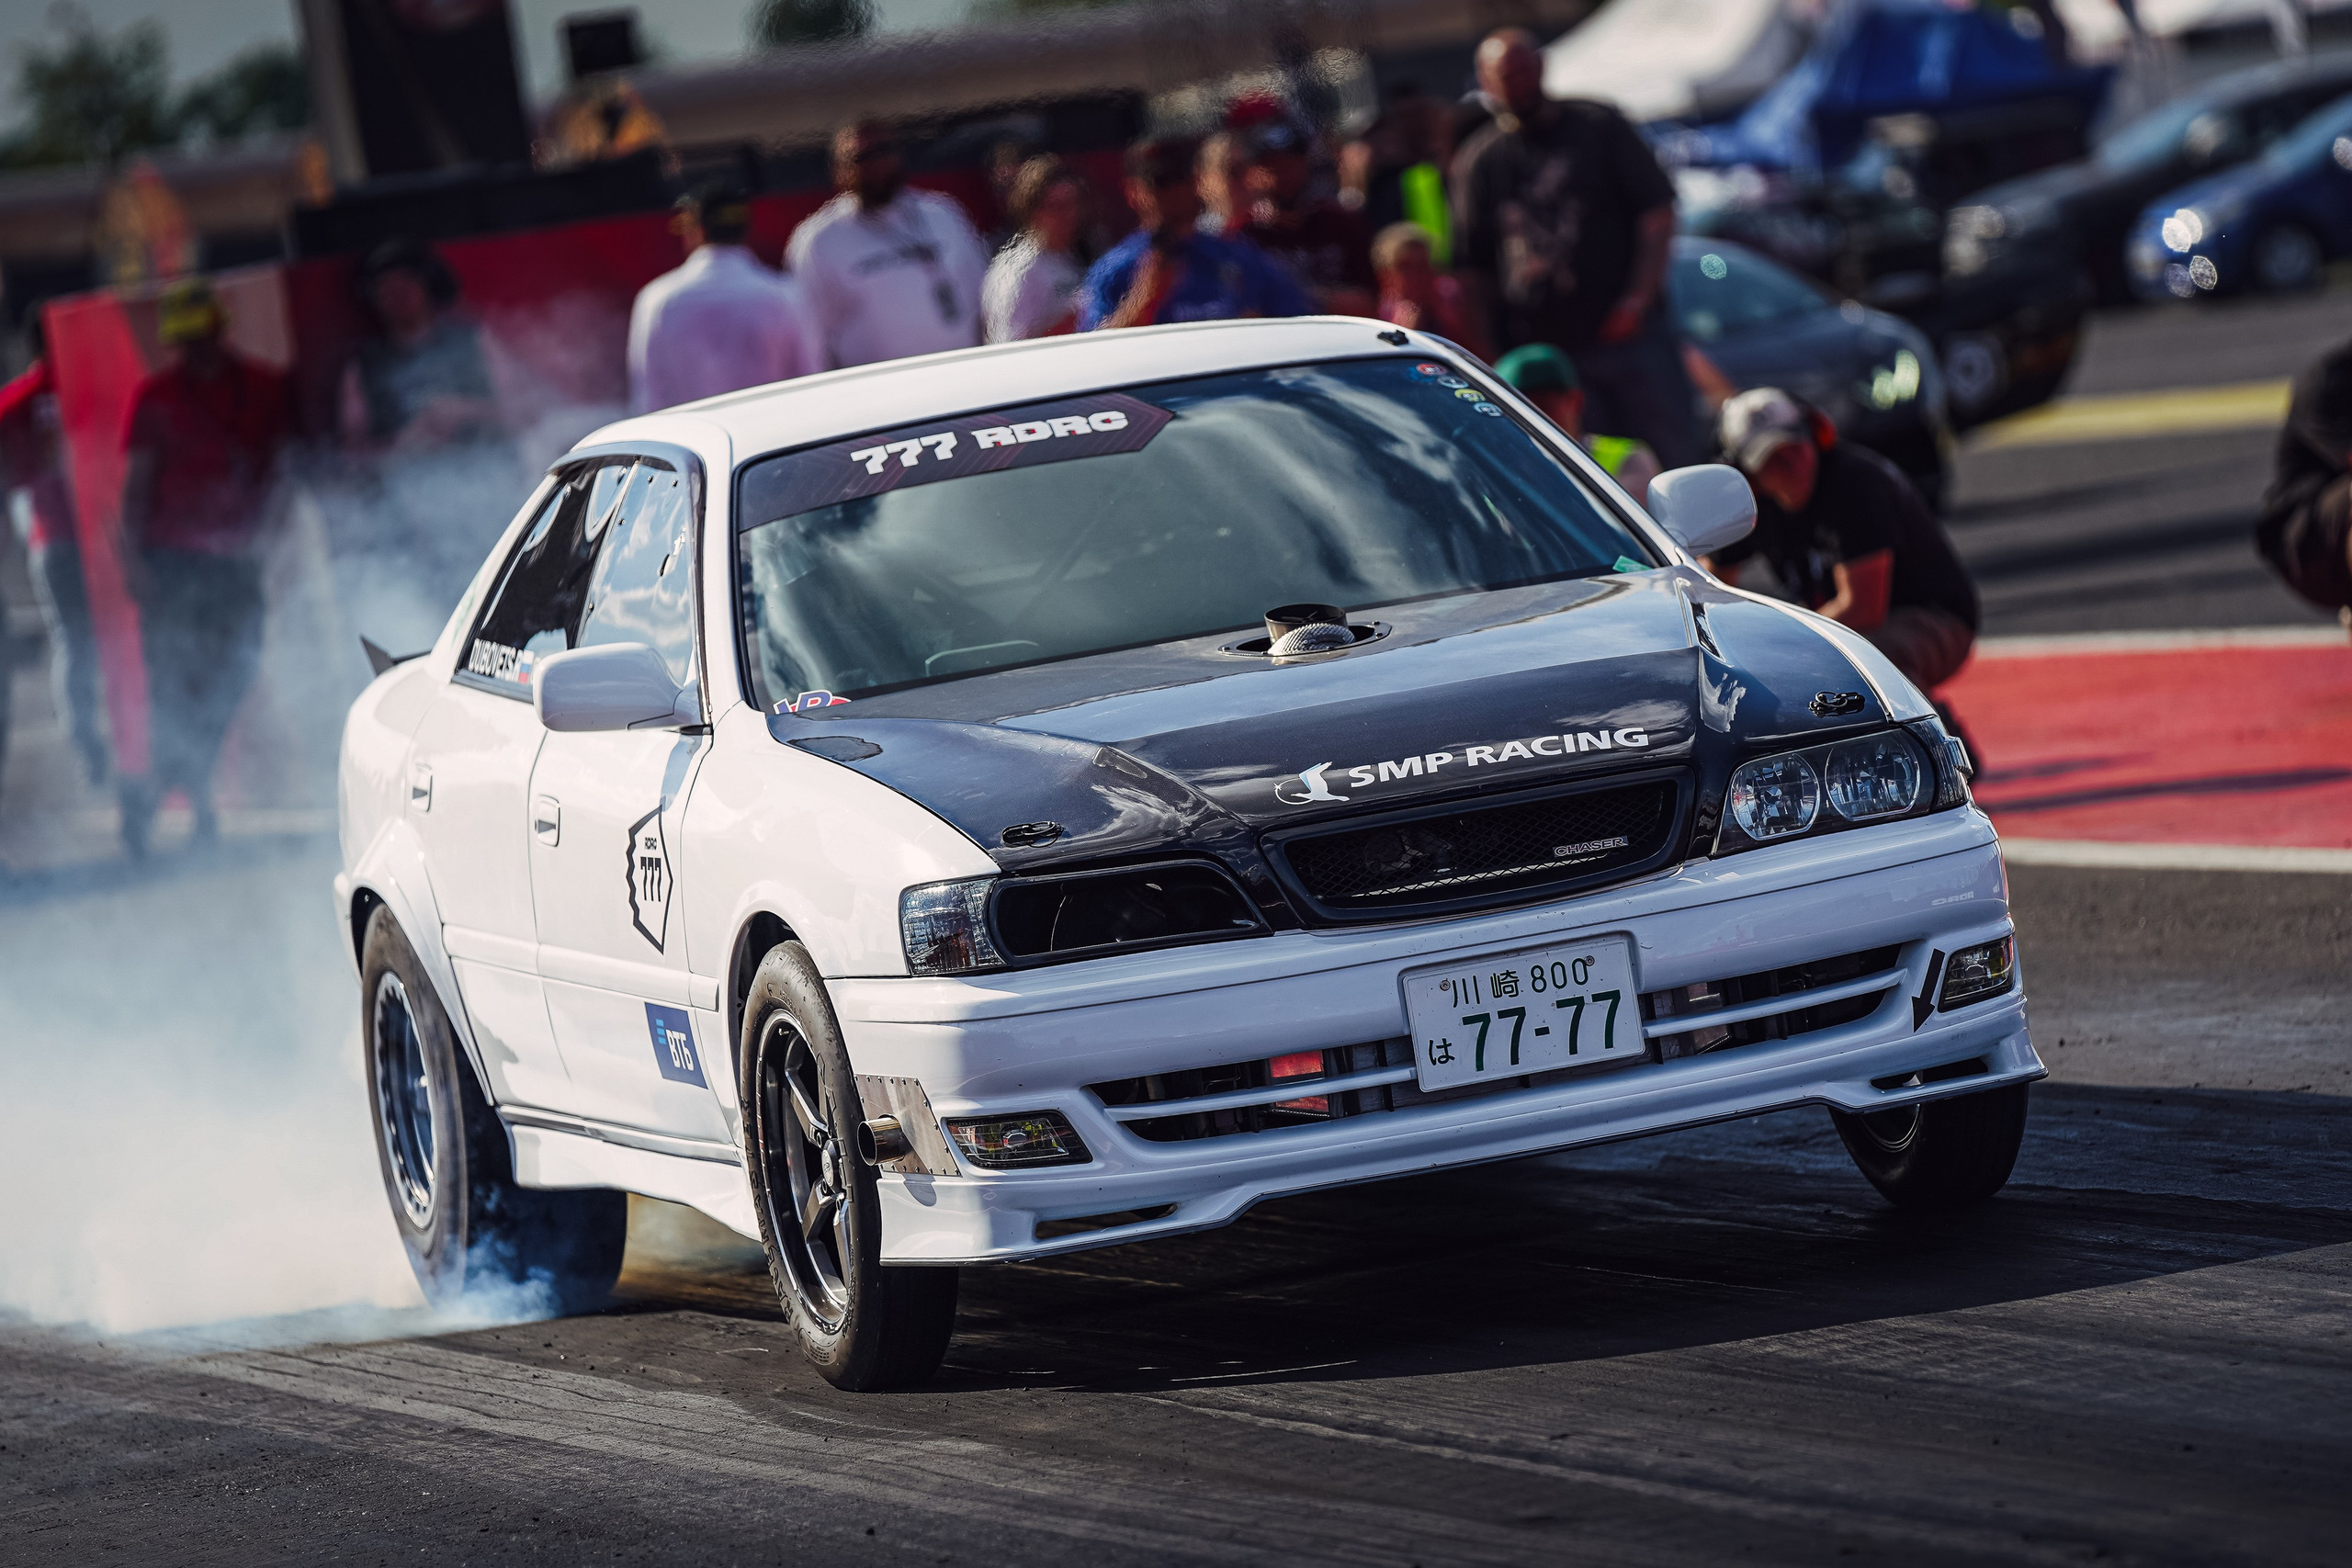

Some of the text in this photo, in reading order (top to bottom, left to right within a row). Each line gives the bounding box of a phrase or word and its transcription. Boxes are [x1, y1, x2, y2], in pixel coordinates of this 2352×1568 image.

[850, 410, 1128, 475] 777 RDRC
[1349, 728, 1649, 789] SMP RACING
[1555, 836, 1627, 856] CHASER
[640, 856, 662, 904] 777
[1453, 957, 1589, 1009] 川崎 800
[666, 1029, 695, 1072] ВТБ
[1428, 989, 1622, 1072] は 77-77
